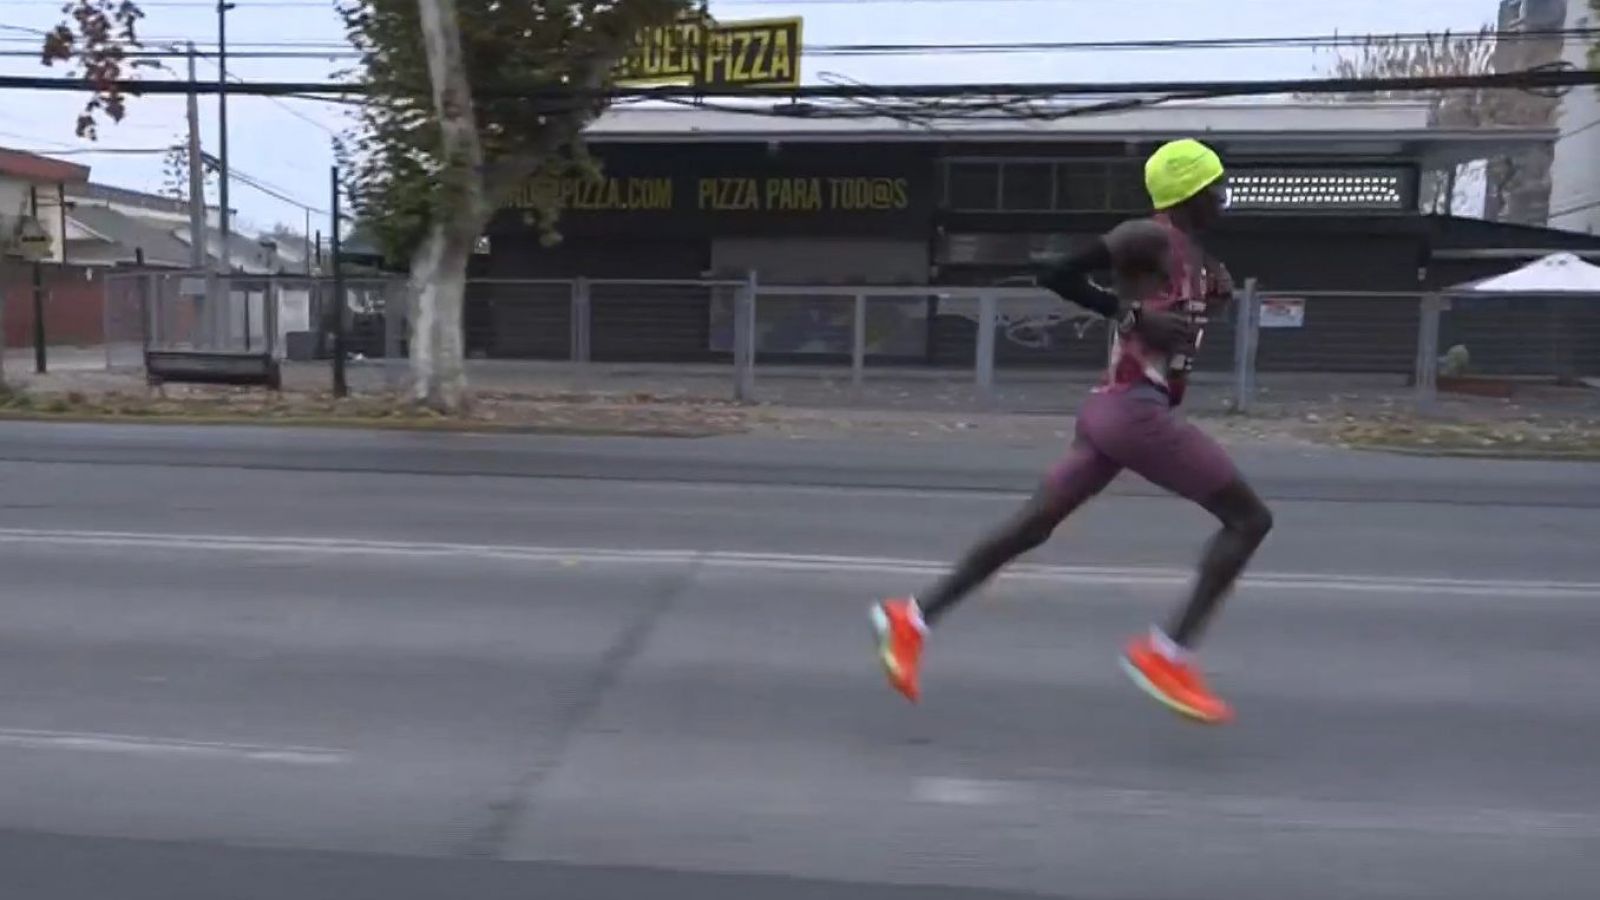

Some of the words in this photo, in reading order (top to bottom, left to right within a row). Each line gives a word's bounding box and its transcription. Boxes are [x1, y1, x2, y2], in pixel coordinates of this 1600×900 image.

[704, 28, 790, 83] PIZZA
[698, 177, 759, 210] PIZZA
[766, 177, 822, 210] PARA
[827, 176, 909, 210] TOD@S
